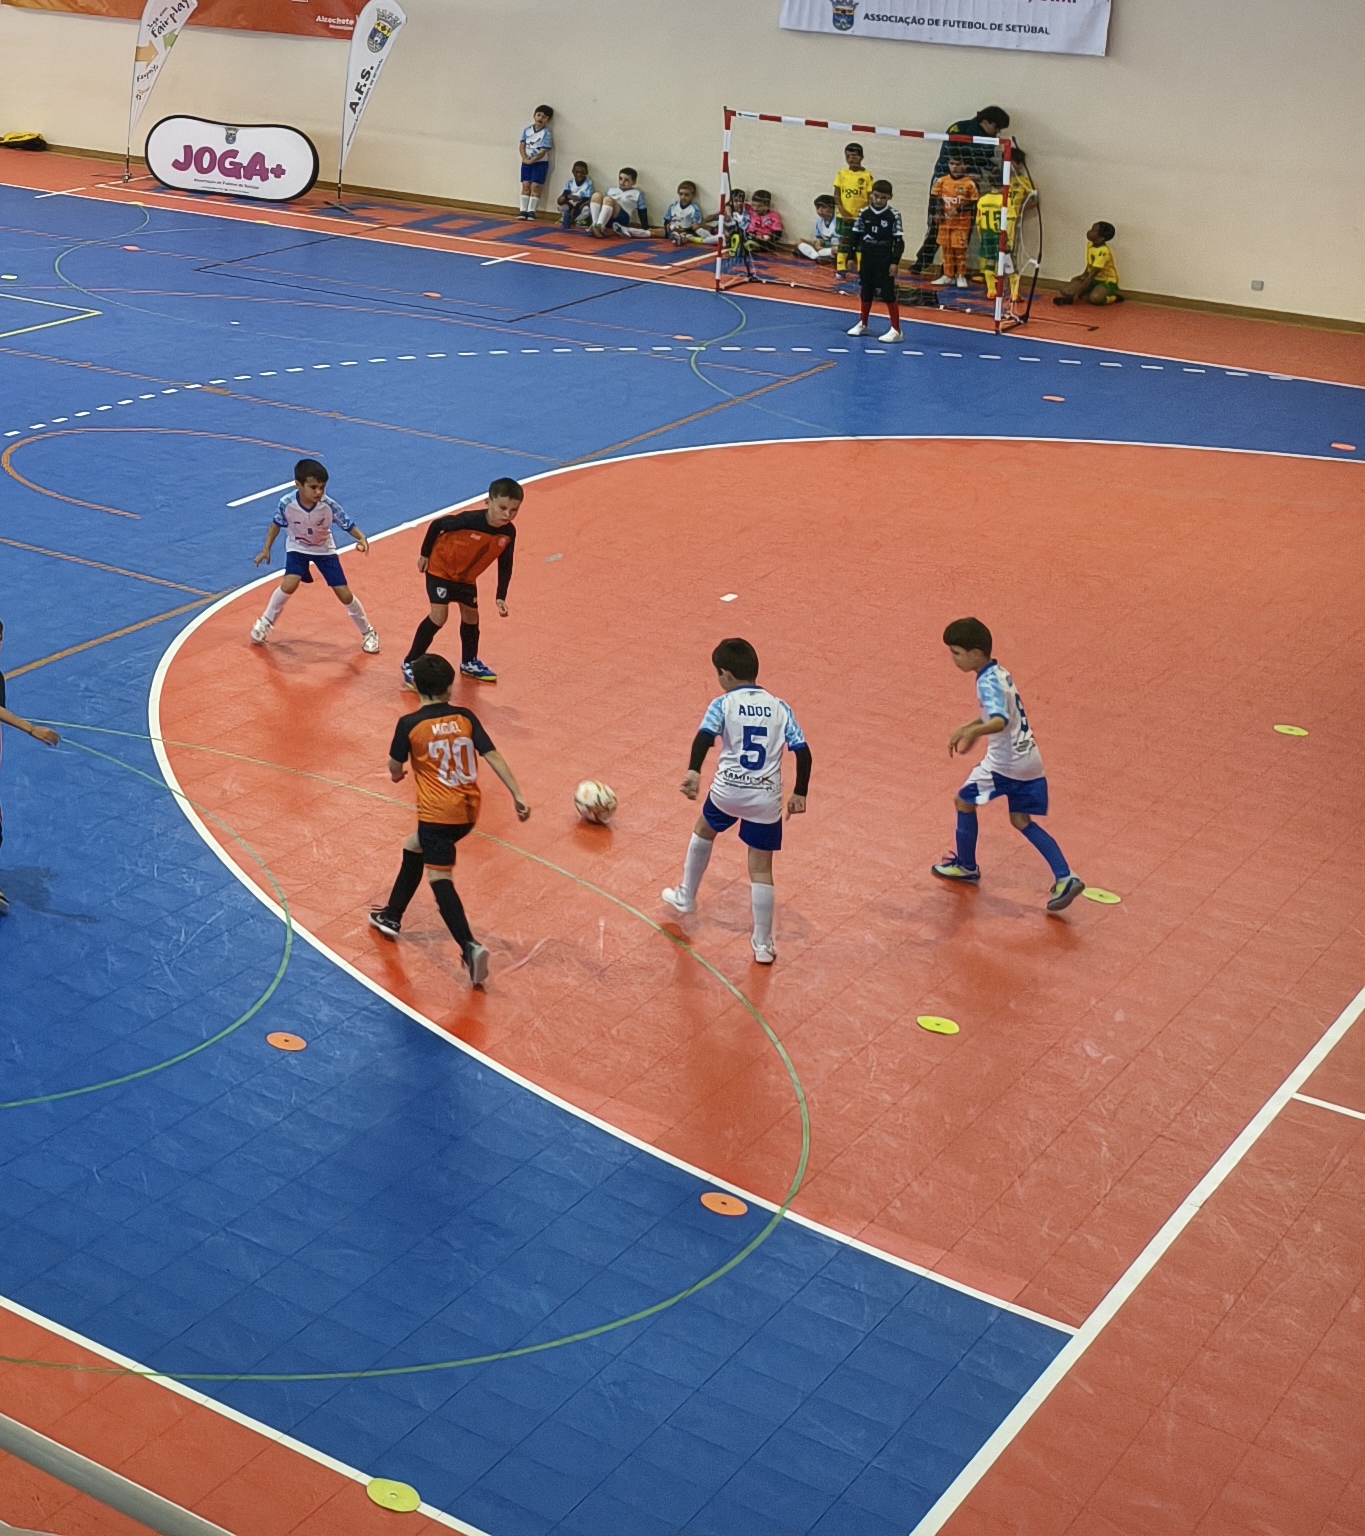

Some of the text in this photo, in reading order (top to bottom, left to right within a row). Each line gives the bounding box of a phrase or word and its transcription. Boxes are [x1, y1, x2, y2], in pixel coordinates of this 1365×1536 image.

[863, 12, 1051, 35] ASSOCIAÇÃO DE FUTEBOL DE SETÚBAL
[171, 144, 287, 182] JOGA+
[428, 736, 477, 787] 20
[740, 725, 767, 771] 5
